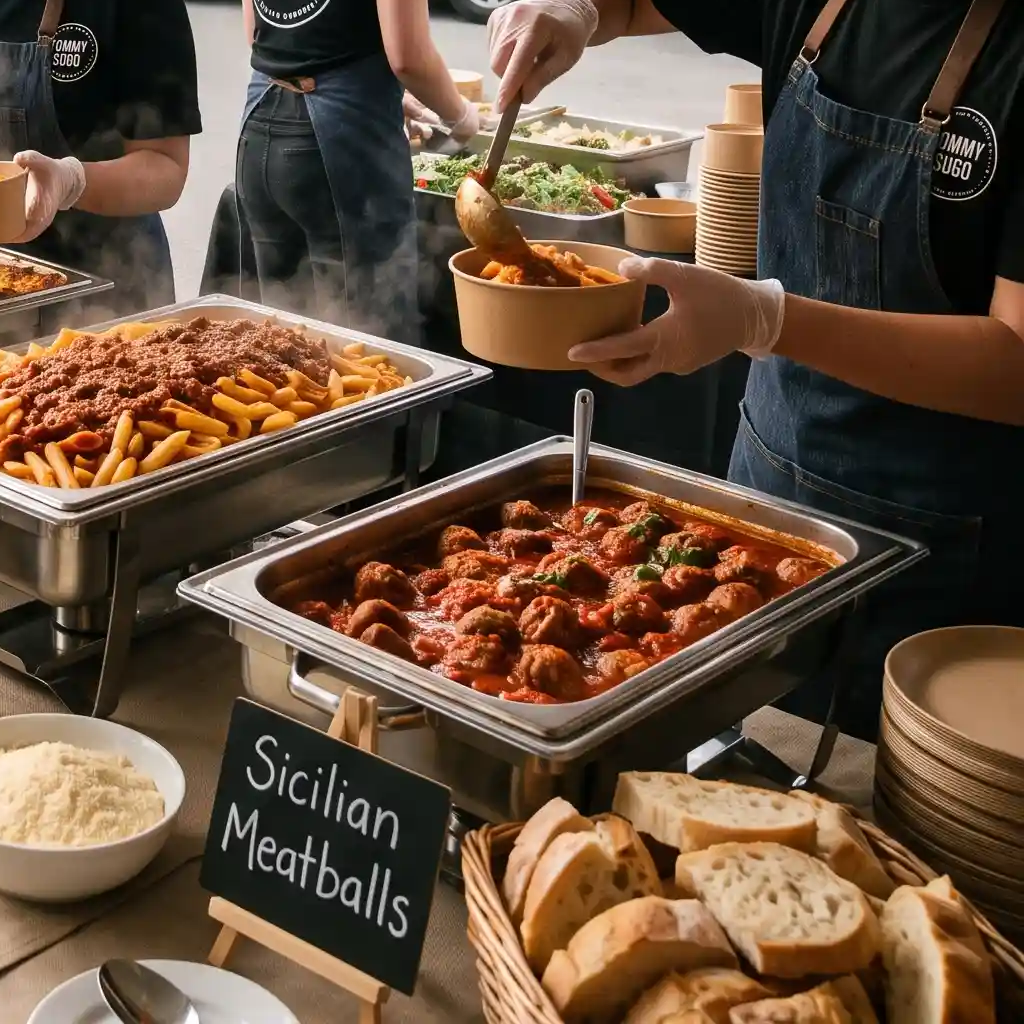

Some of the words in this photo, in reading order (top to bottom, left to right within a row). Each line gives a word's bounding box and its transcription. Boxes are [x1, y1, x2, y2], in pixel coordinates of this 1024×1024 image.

[933, 152, 973, 181] SUGO
[939, 131, 986, 161] OMMY
[246, 734, 400, 850] Sicilian
[221, 802, 410, 938] Meatballs
